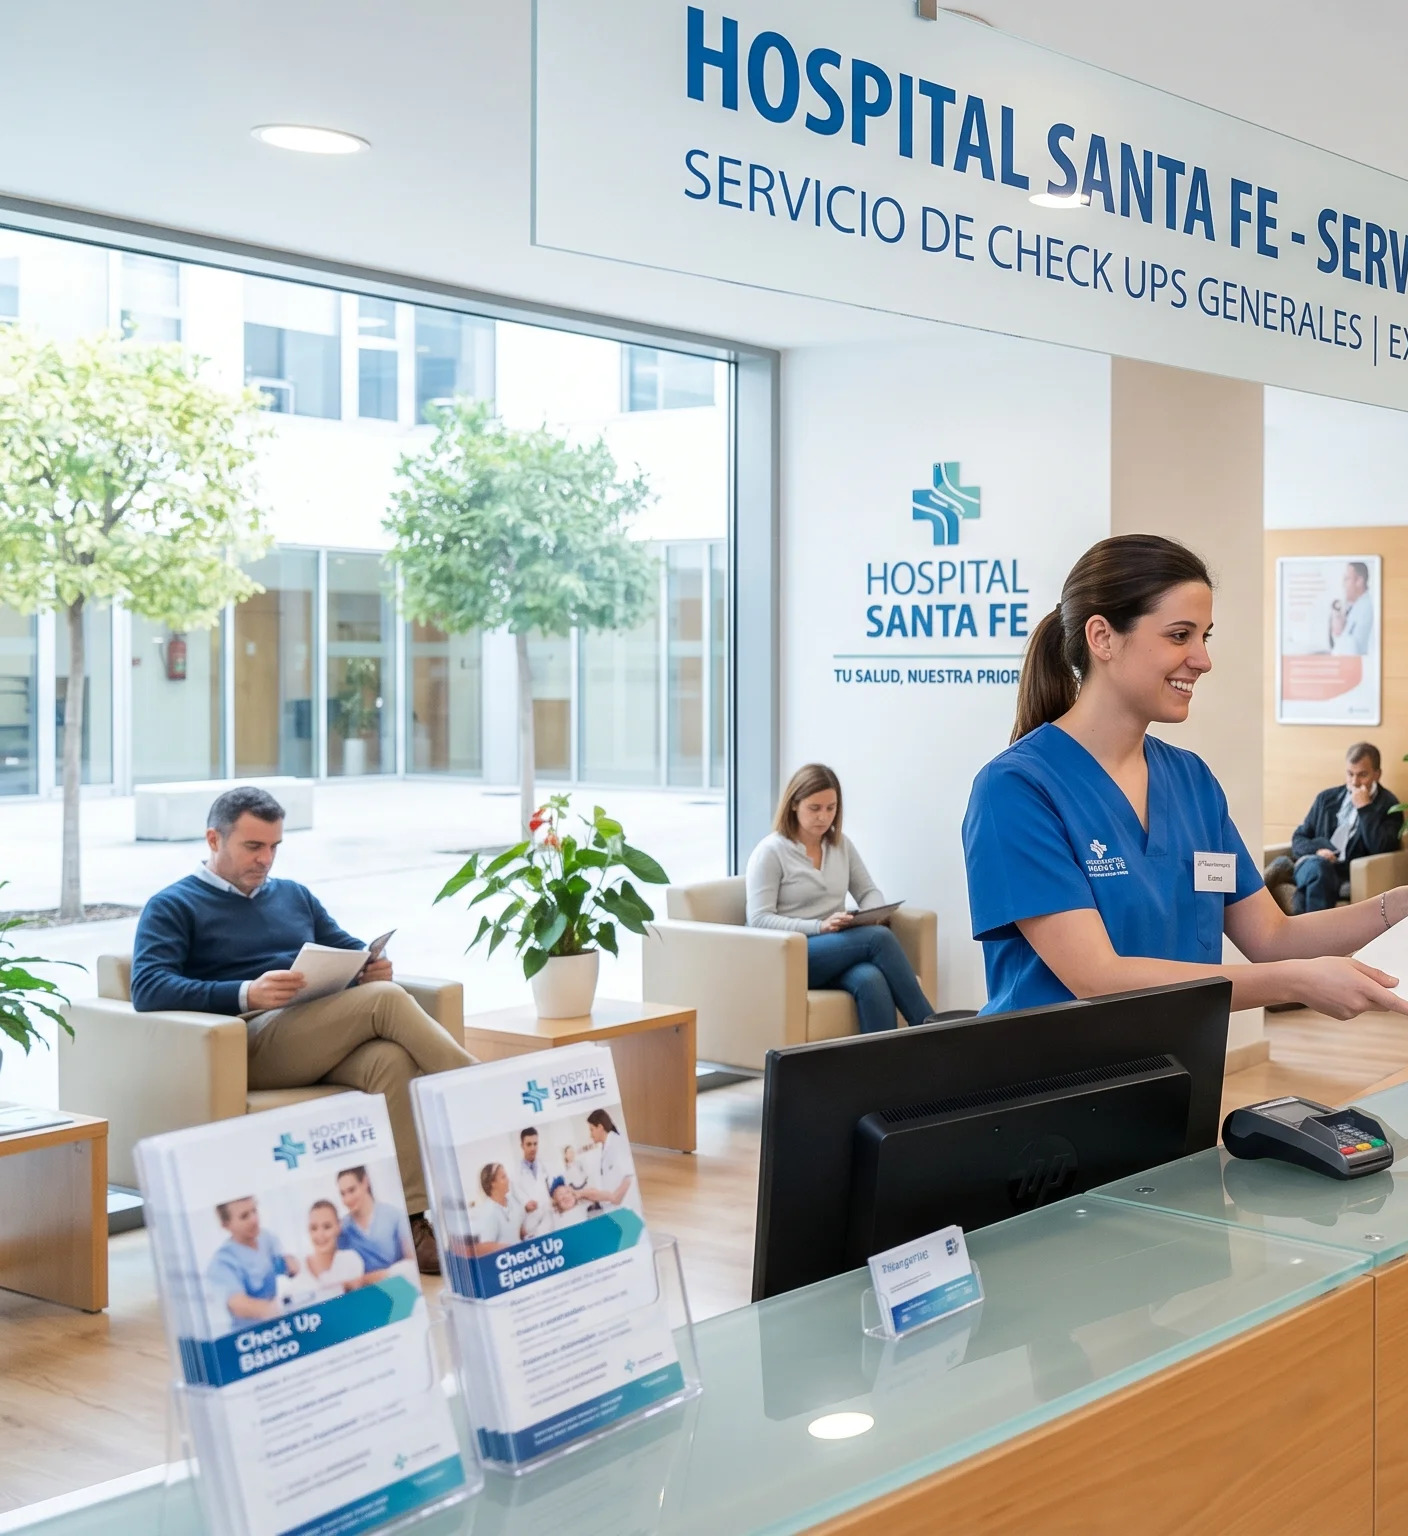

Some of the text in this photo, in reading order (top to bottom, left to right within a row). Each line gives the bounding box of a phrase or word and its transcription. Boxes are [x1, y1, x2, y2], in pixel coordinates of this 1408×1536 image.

[686, 5, 1030, 191] HOSPITAL
[1046, 122, 1216, 242] SANTA
[1230, 177, 1279, 260] FE
[1291, 231, 1306, 246] -
[684, 148, 906, 244] SERVICIO
[921, 206, 975, 262] DE
[988, 225, 1114, 293] CHECK
[1124, 256, 1188, 309] UPS
[1197, 277, 1363, 351] GENERALES
[866, 559, 1029, 596] HOSPITAL
[866, 602, 1029, 638] SANTA FE
[834, 669, 1020, 685] TU SALUD, NUESTRA PRIOR
[551, 1067, 604, 1088] HOSPITAL
[554, 1078, 605, 1100] SANTA FE
[309, 1116, 372, 1140] HOSPITAL
[313, 1127, 376, 1155] SANTA FE
[495, 1237, 564, 1270] Check Up
[498, 1255, 565, 1290] Ejecutivo
[234, 1319, 294, 1354] Check
[293, 1312, 322, 1333] Up
